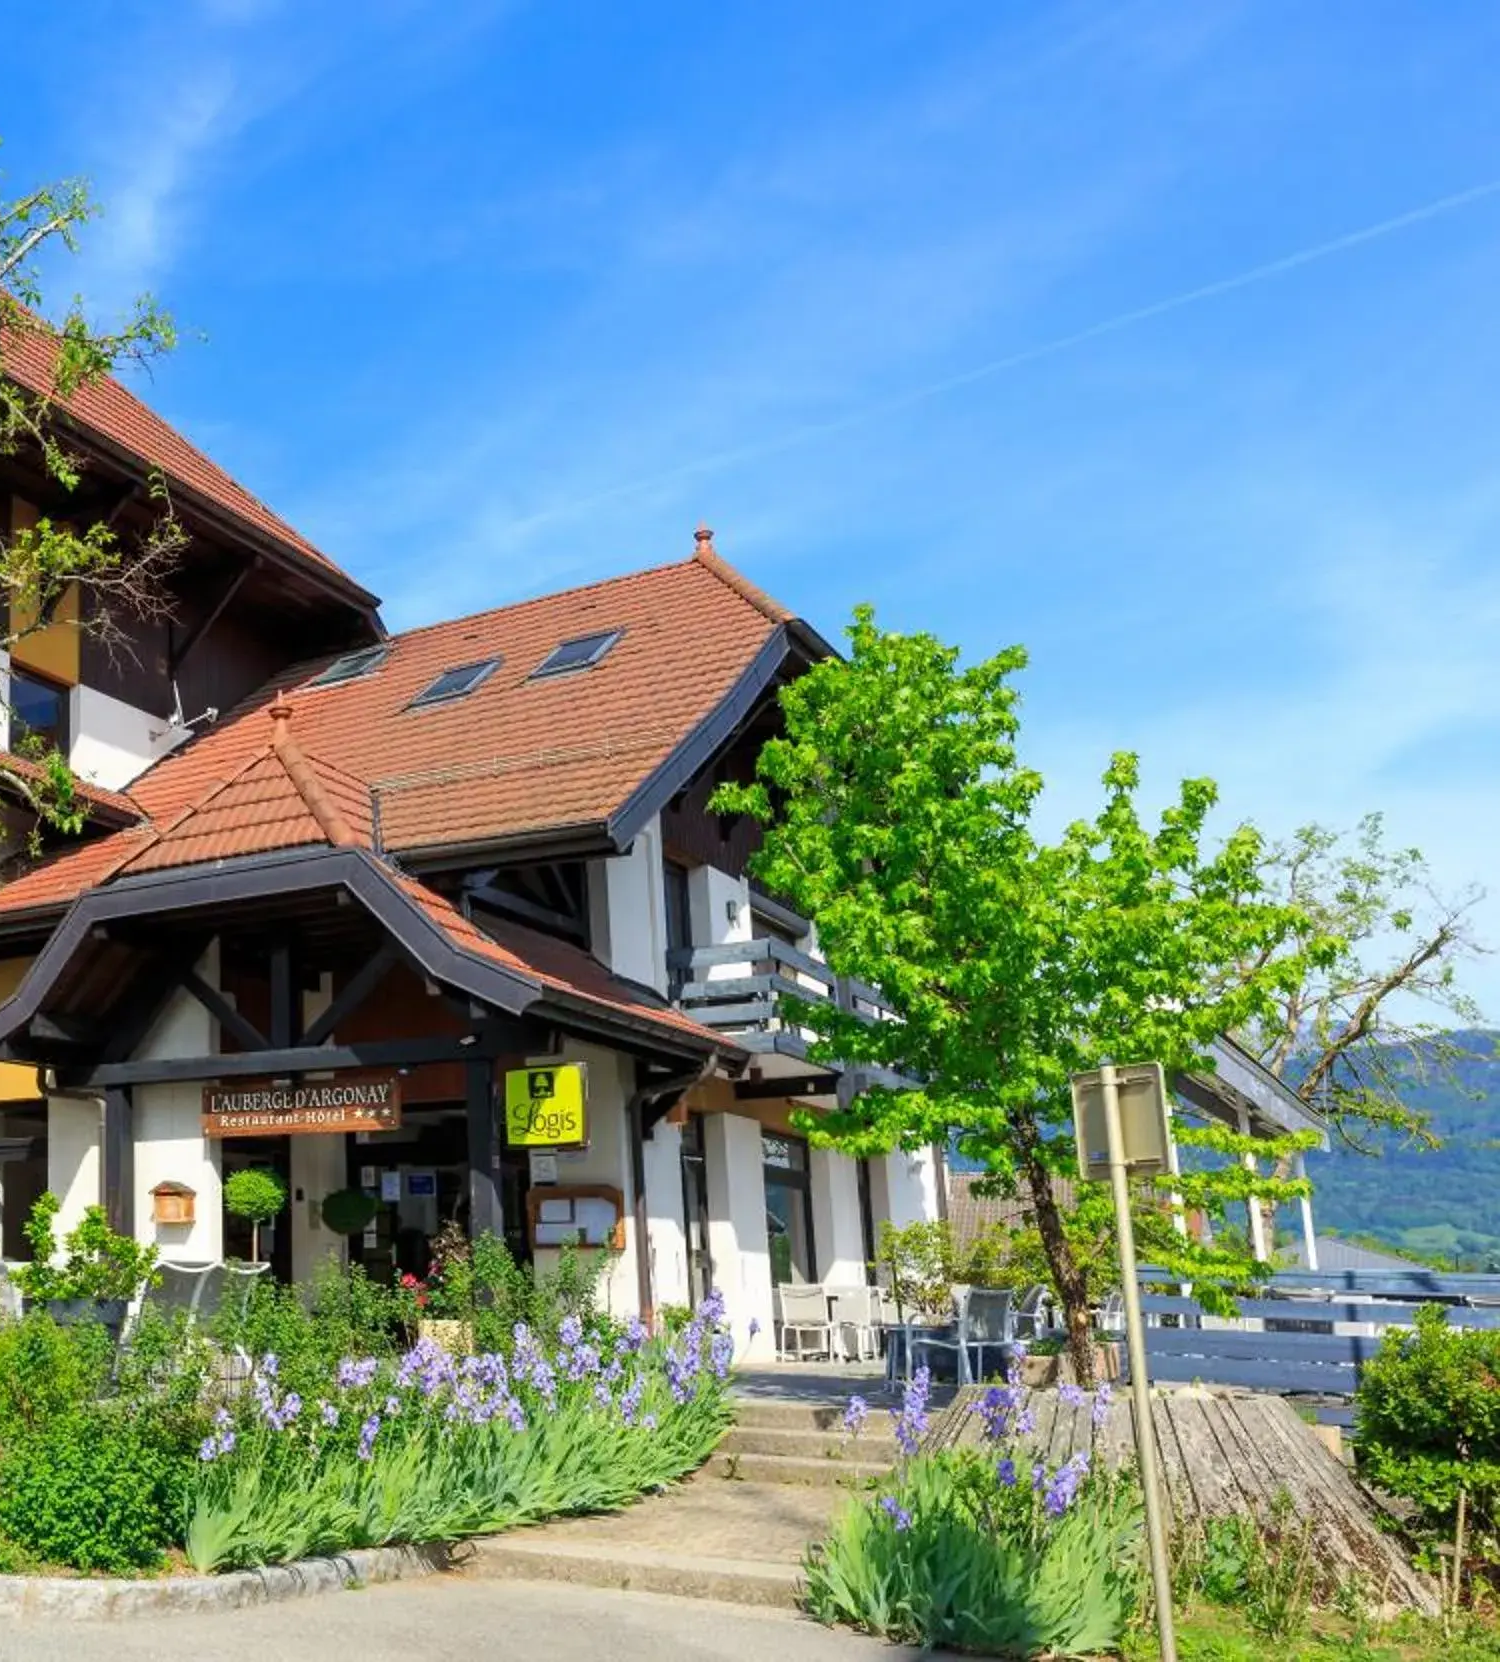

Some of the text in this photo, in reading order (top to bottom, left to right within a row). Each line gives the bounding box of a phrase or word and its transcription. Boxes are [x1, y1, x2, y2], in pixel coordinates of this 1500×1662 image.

[211, 1083, 388, 1113] L'AUBERGE D'ARGONAY
[512, 1099, 577, 1138] Logis
